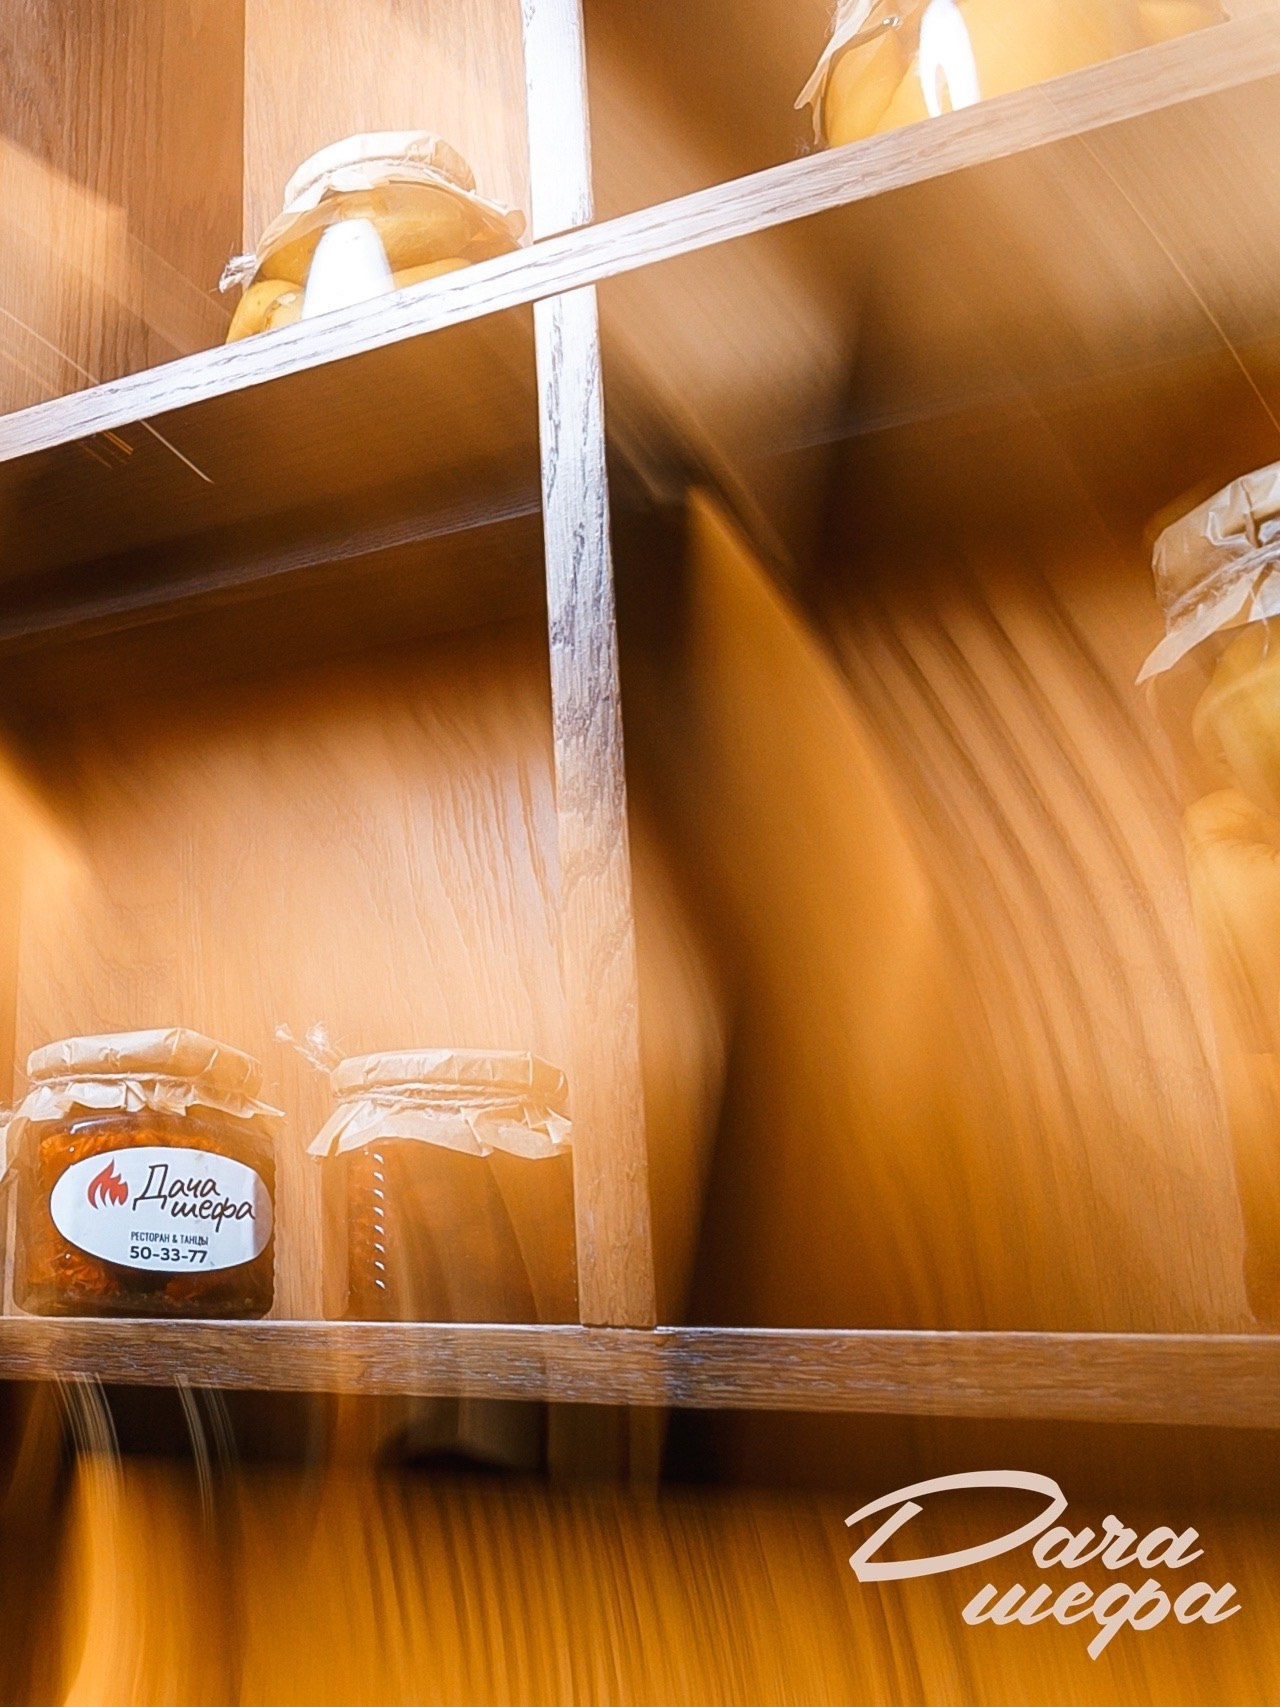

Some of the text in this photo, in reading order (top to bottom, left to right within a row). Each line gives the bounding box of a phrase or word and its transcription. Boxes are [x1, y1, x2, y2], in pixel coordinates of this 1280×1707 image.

[132, 1163, 220, 1211] Дача
[170, 1197, 256, 1232] шефа
[130, 1231, 209, 1246] РЕСТОРАН & ТАНЦЫ
[129, 1245, 208, 1263] 50-33-77
